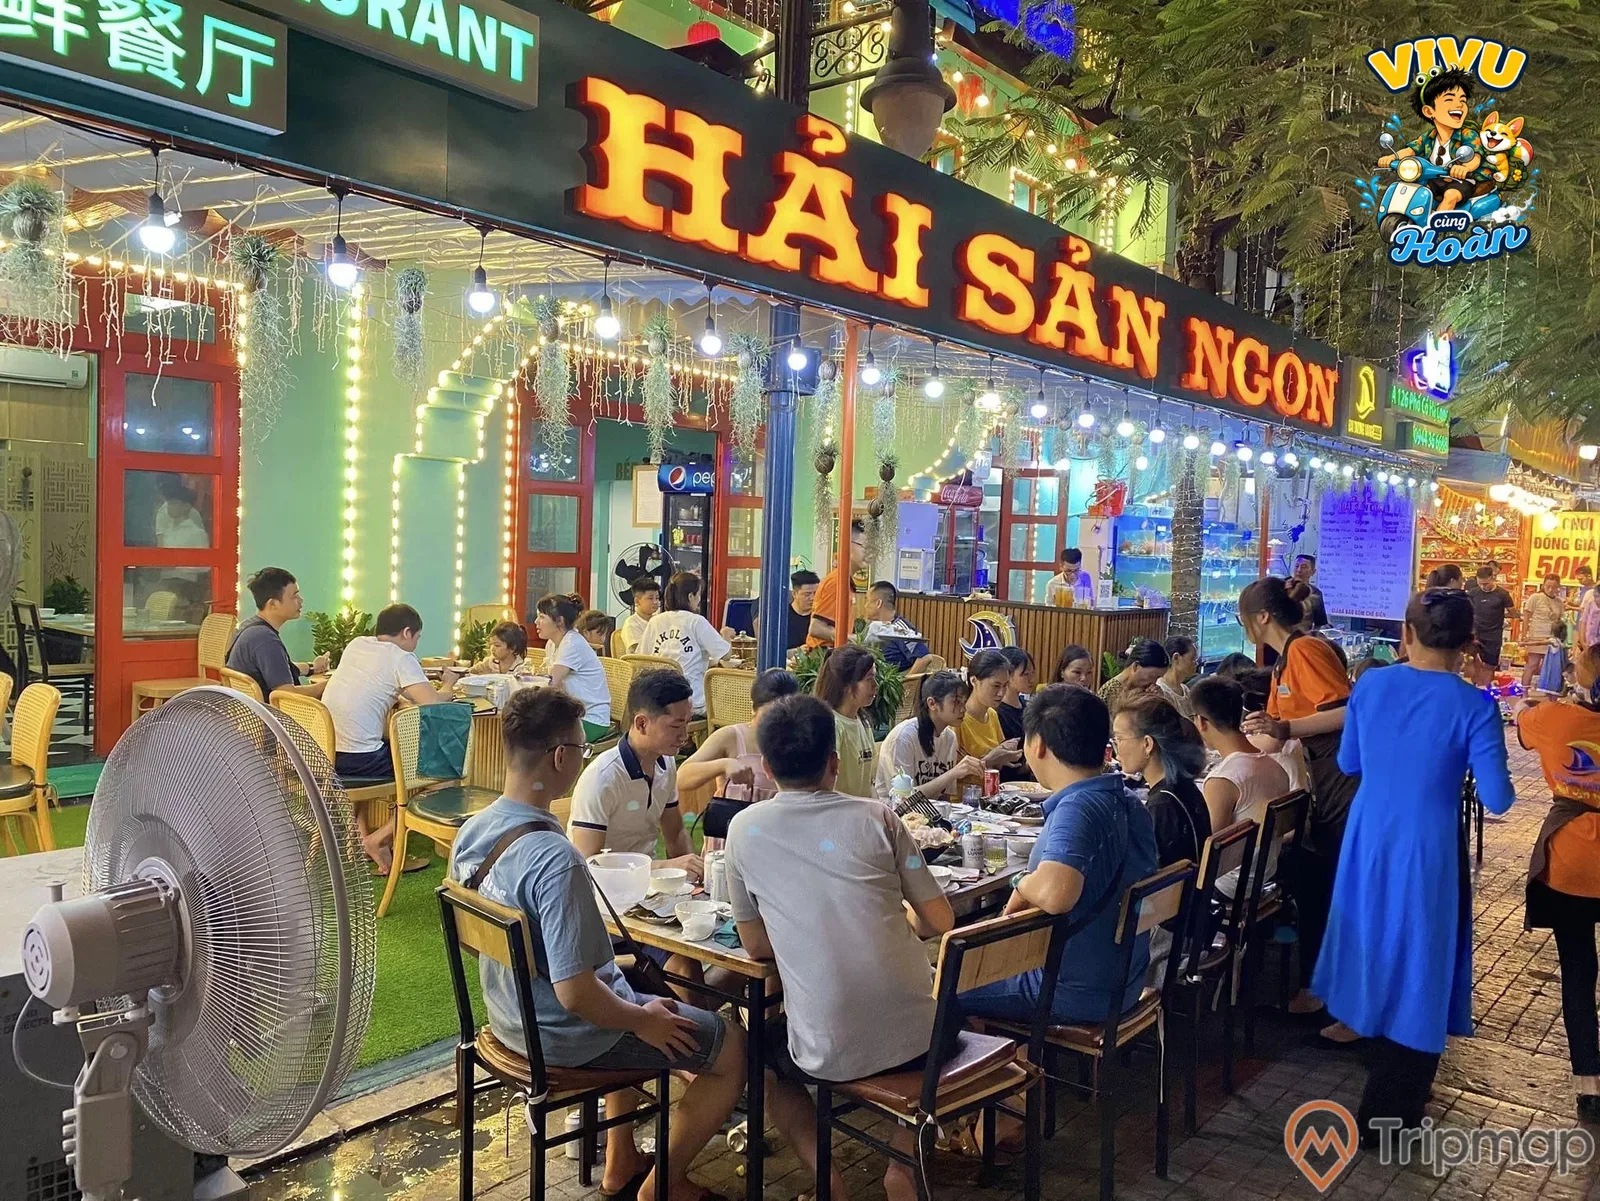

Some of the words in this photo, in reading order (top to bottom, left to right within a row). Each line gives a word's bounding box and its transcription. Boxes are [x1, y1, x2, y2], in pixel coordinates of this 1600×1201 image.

[575, 76, 936, 309] HẢI
[958, 233, 1166, 380] SẢN
[1180, 316, 1340, 429] NGON
[1574, 536, 1597, 552] GIÁ
[1535, 554, 1591, 580] 50K
[653, 628, 694, 654] NIKOLAS
